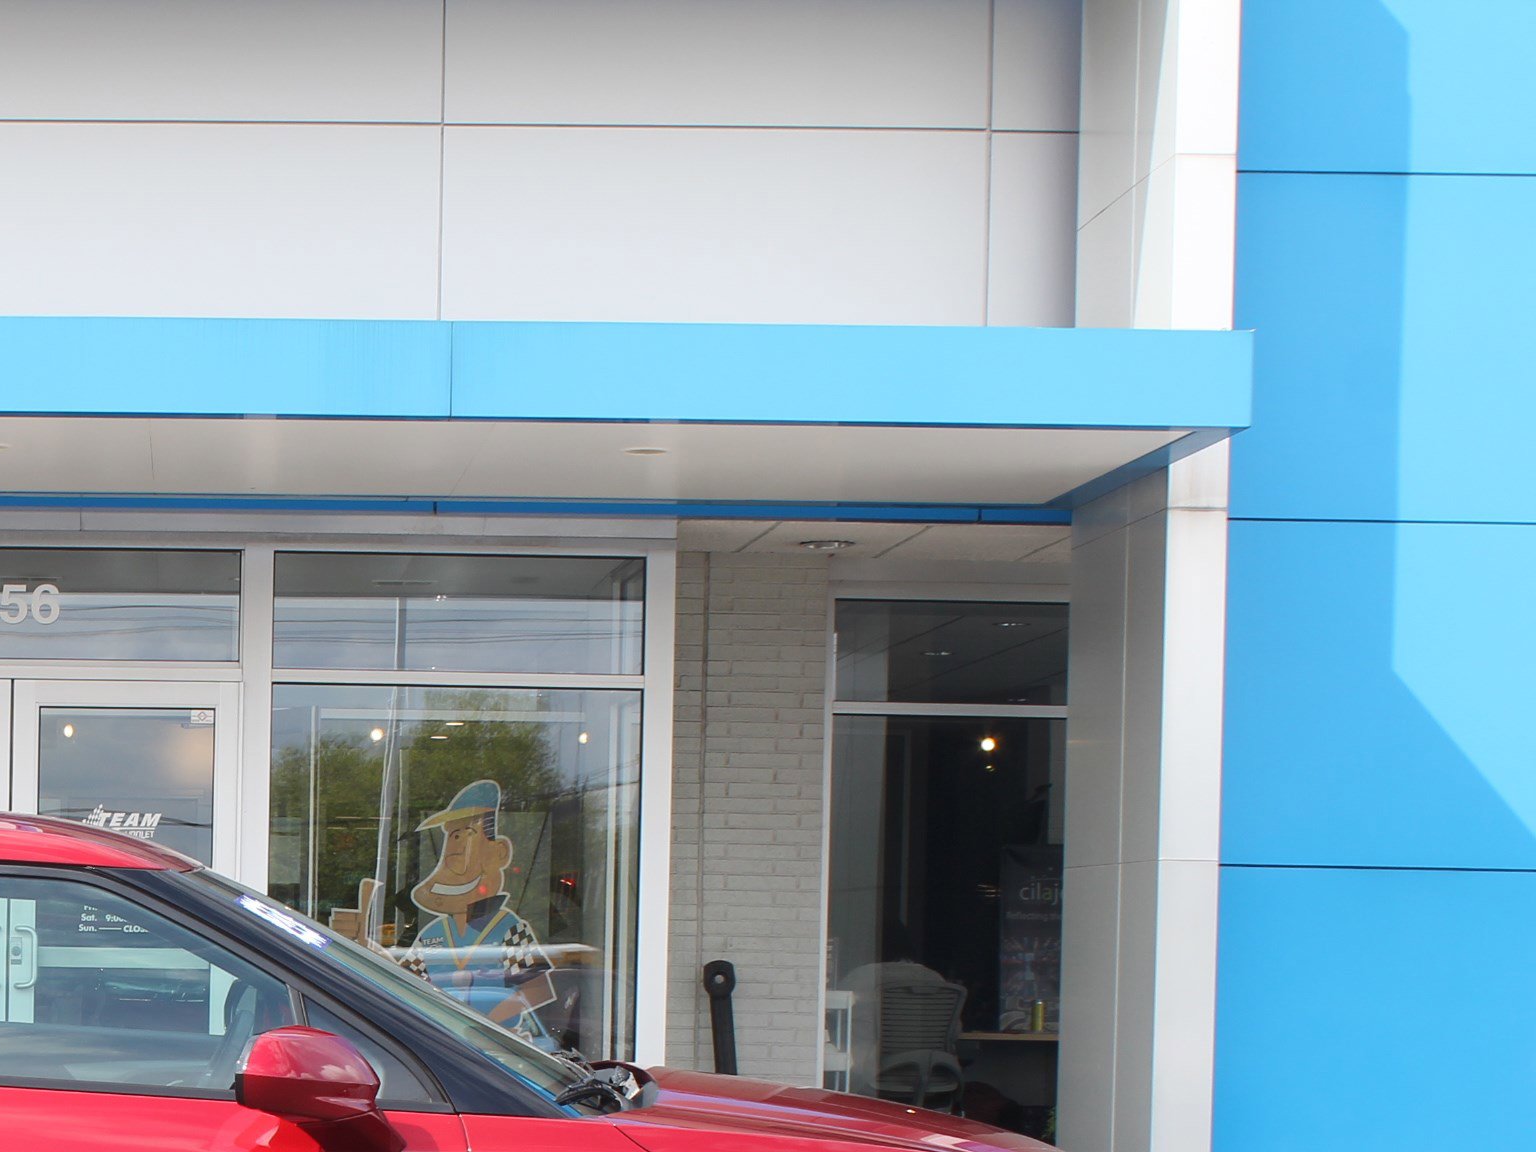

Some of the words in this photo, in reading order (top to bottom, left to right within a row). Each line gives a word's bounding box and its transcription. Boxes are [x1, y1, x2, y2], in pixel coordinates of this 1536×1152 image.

[100, 812, 162, 827] TEAM
[81, 913, 97, 922] Sat.
[78, 924, 97, 932] Sun.
[422, 937, 445, 945] TEAM
